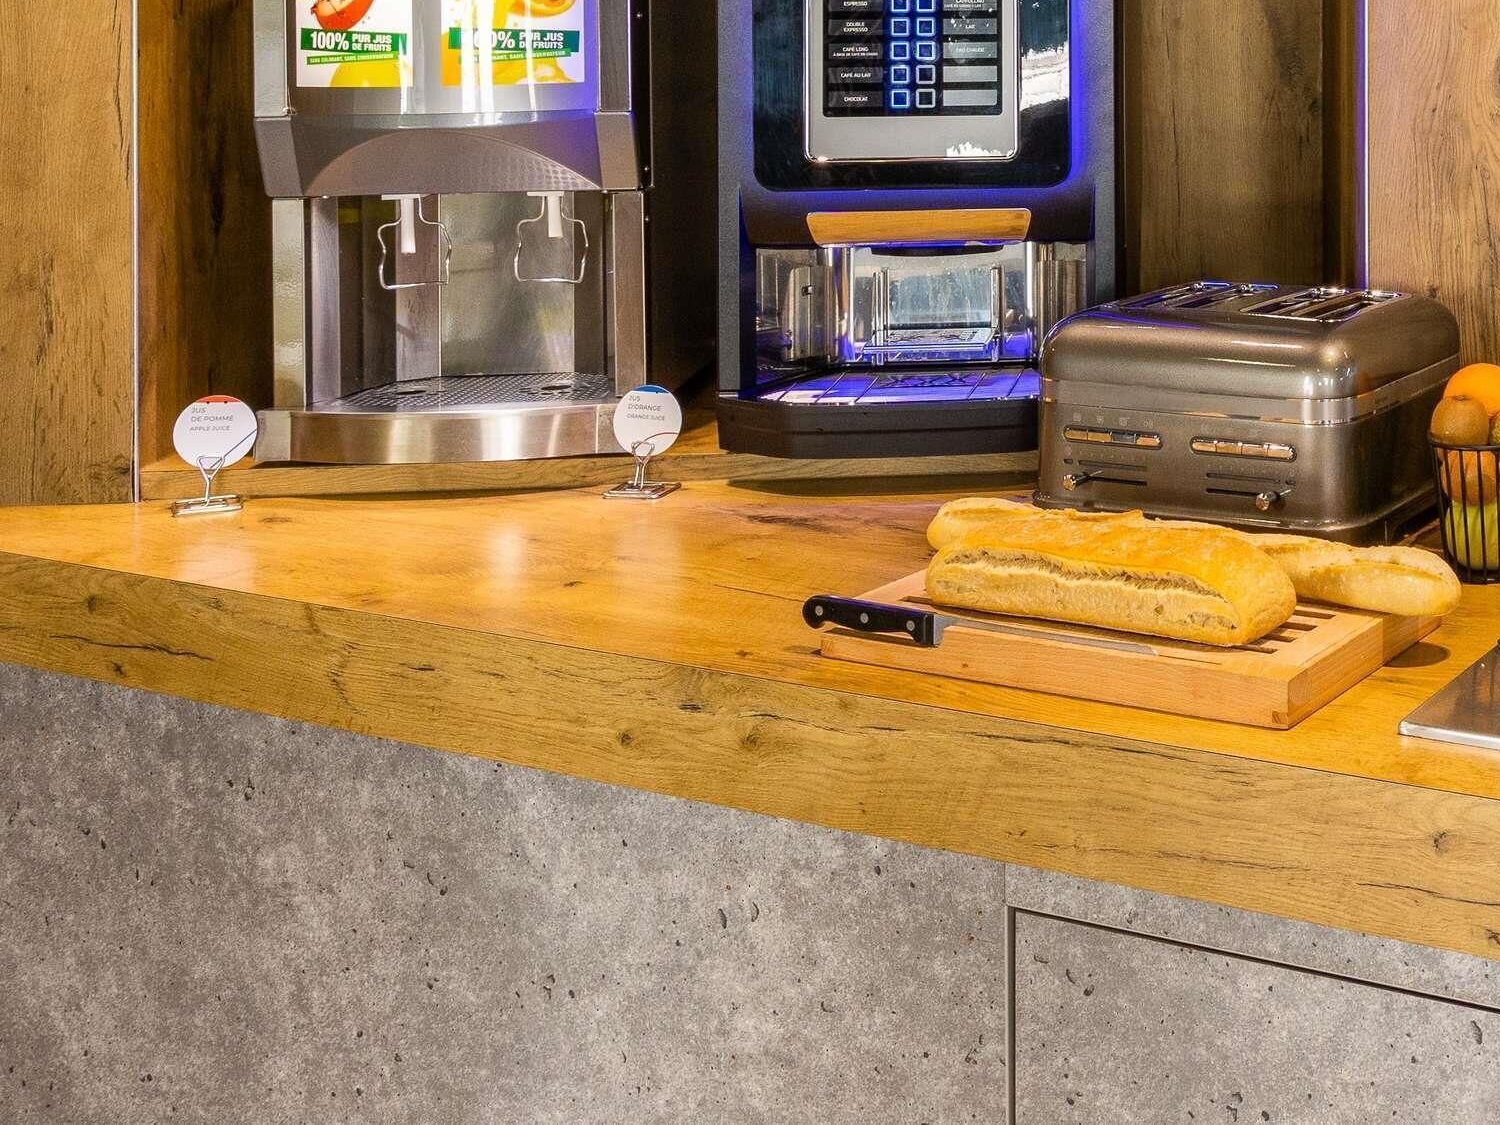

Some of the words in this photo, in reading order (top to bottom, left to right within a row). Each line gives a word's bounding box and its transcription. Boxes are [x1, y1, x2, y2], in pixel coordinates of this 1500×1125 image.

[310, 31, 350, 51] 100%
[351, 33, 372, 43] PUR
[373, 33, 392, 44] JUS
[519, 31, 541, 41] PR
[543, 32, 564, 42] JUS
[351, 43, 362, 51] DE
[363, 43, 392, 52] FRUITS
